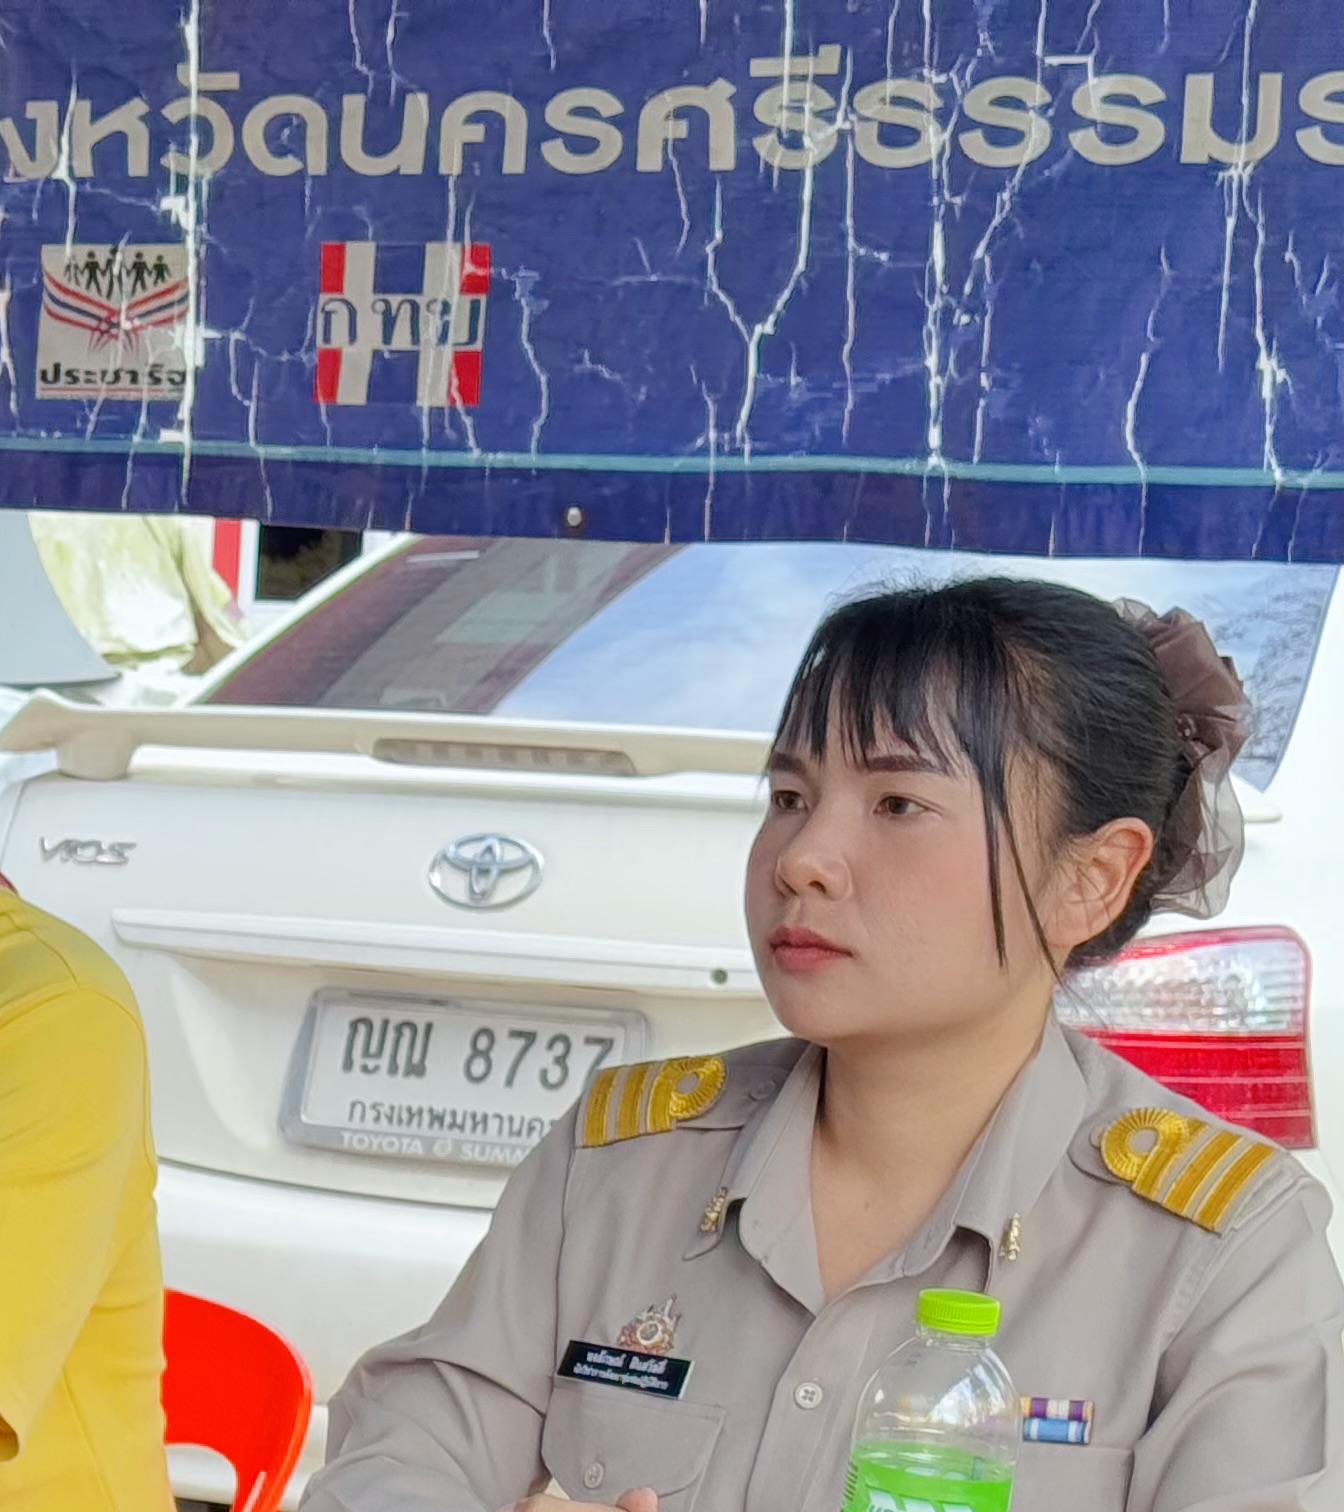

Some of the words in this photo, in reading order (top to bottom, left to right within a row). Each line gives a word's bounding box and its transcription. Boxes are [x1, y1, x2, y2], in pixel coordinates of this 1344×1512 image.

[38, 836, 138, 867] VIOS
[463, 1026, 616, 1092] 8737
[340, 1130, 425, 1156] TOYOTA
